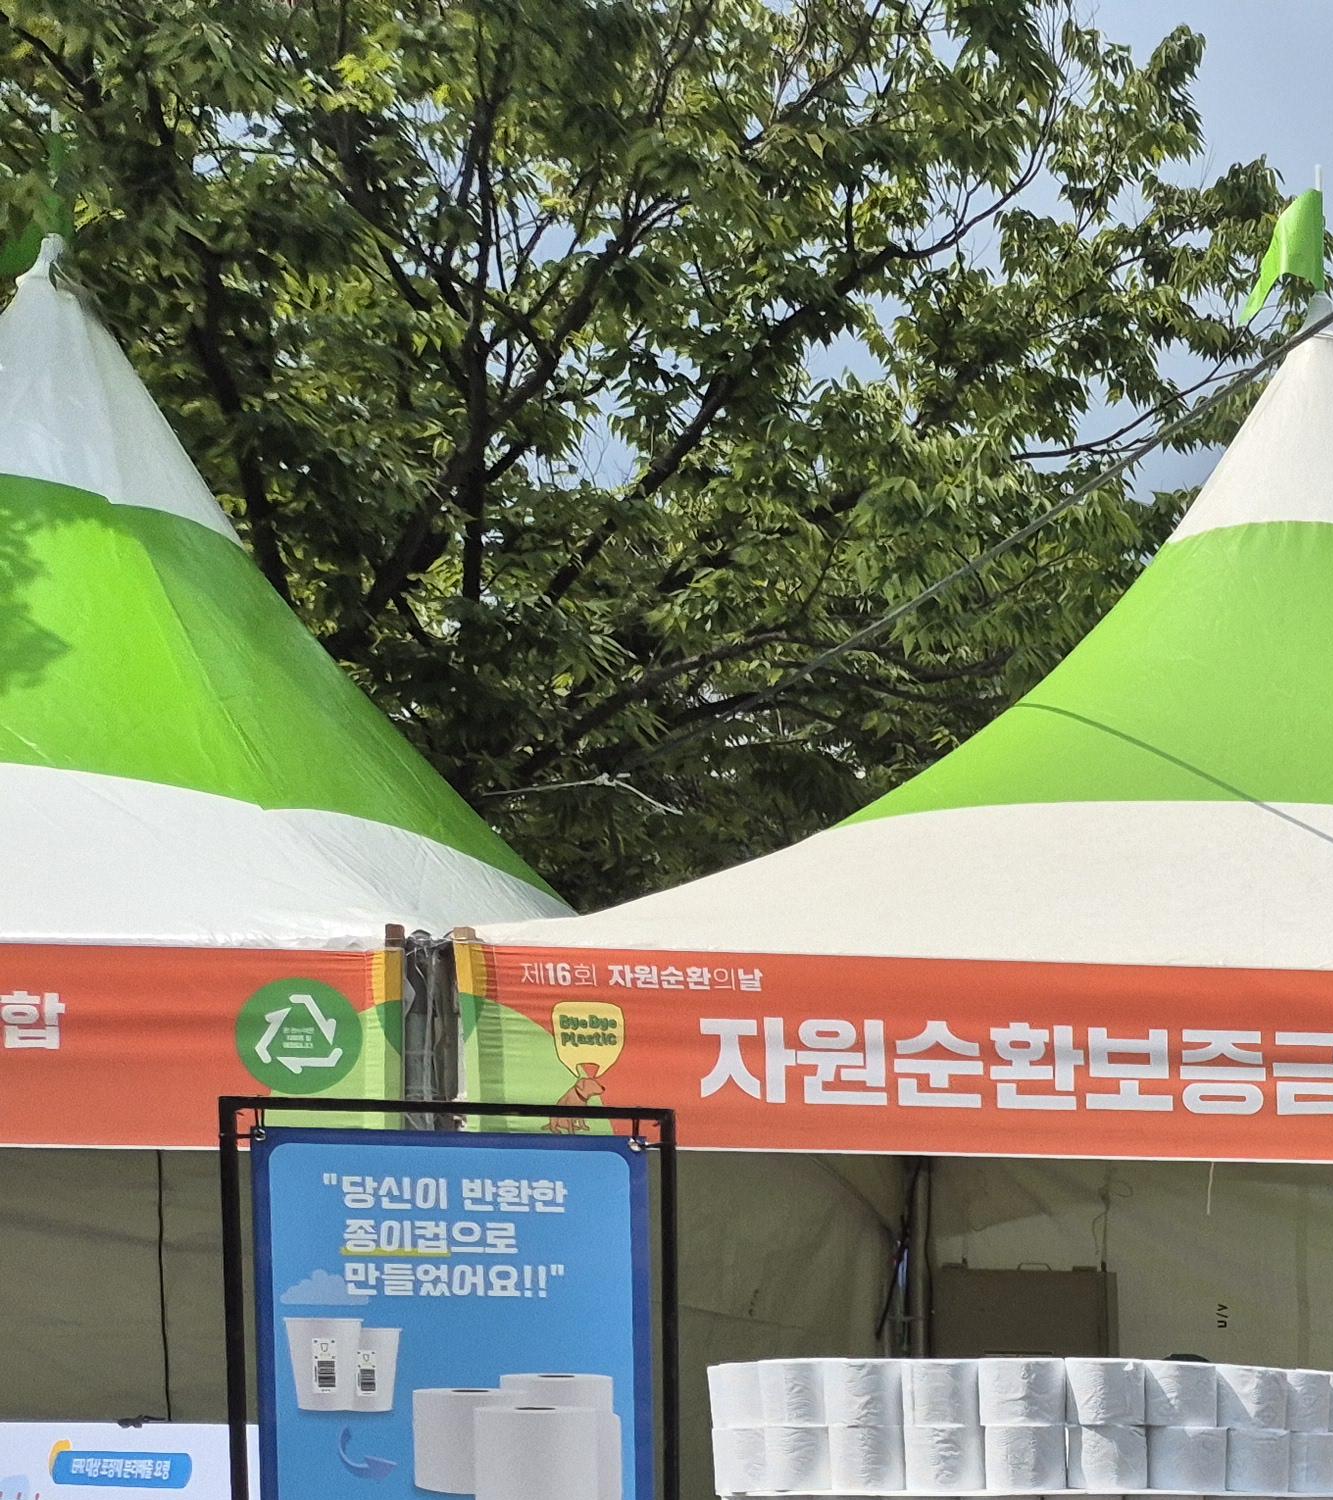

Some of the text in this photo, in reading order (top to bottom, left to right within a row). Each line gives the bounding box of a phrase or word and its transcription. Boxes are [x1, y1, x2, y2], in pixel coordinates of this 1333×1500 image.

[520, 962, 598, 987] 제16회
[462, 1179, 567, 1214] 반환한
[344, 1219, 517, 1253] 종이컵으로
